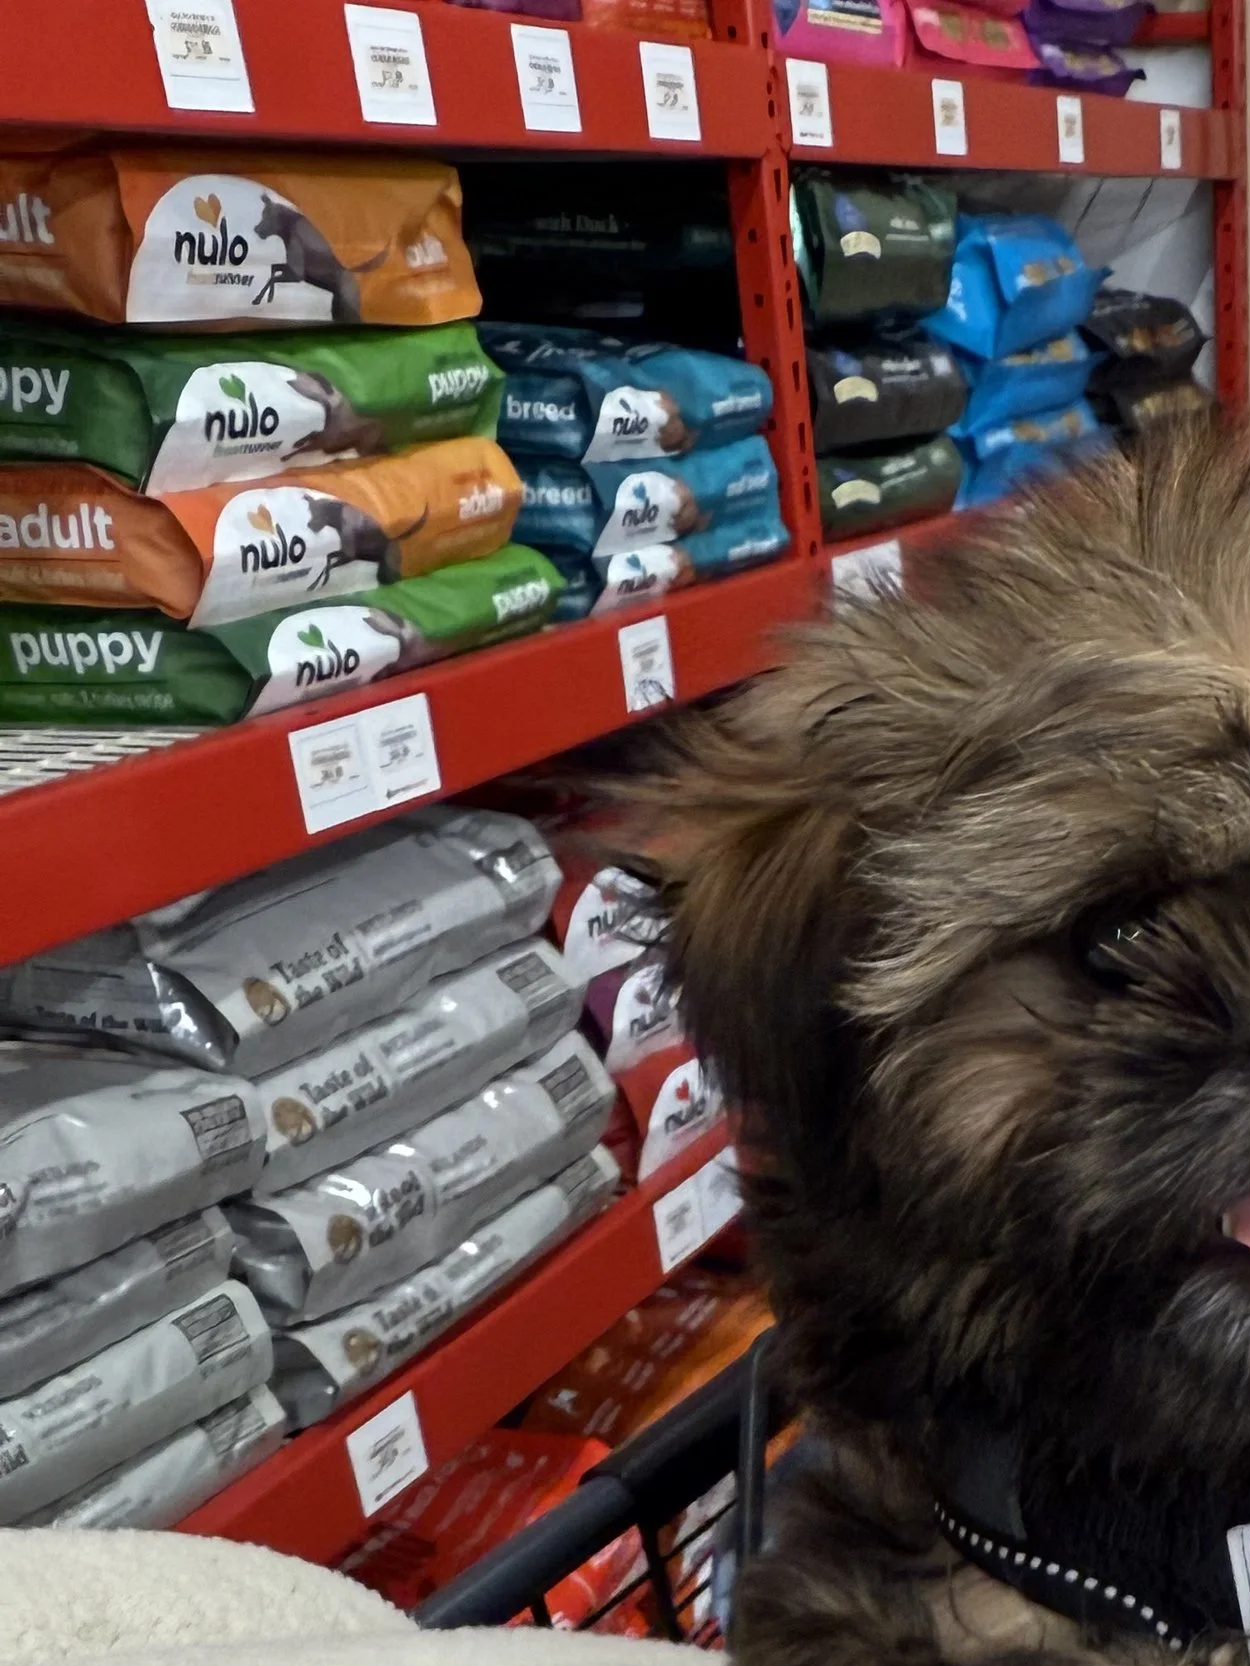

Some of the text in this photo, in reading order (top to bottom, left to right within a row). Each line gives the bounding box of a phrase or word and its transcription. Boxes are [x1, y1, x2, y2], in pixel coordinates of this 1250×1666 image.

[175, 216, 248, 265] nulo
[428, 365, 490, 403] puppy
[204, 392, 279, 442] nulo
[0, 503, 115, 550] adult
[240, 523, 307, 573] nulo
[10, 631, 164, 675] puppy
[296, 639, 360, 688] nulo
